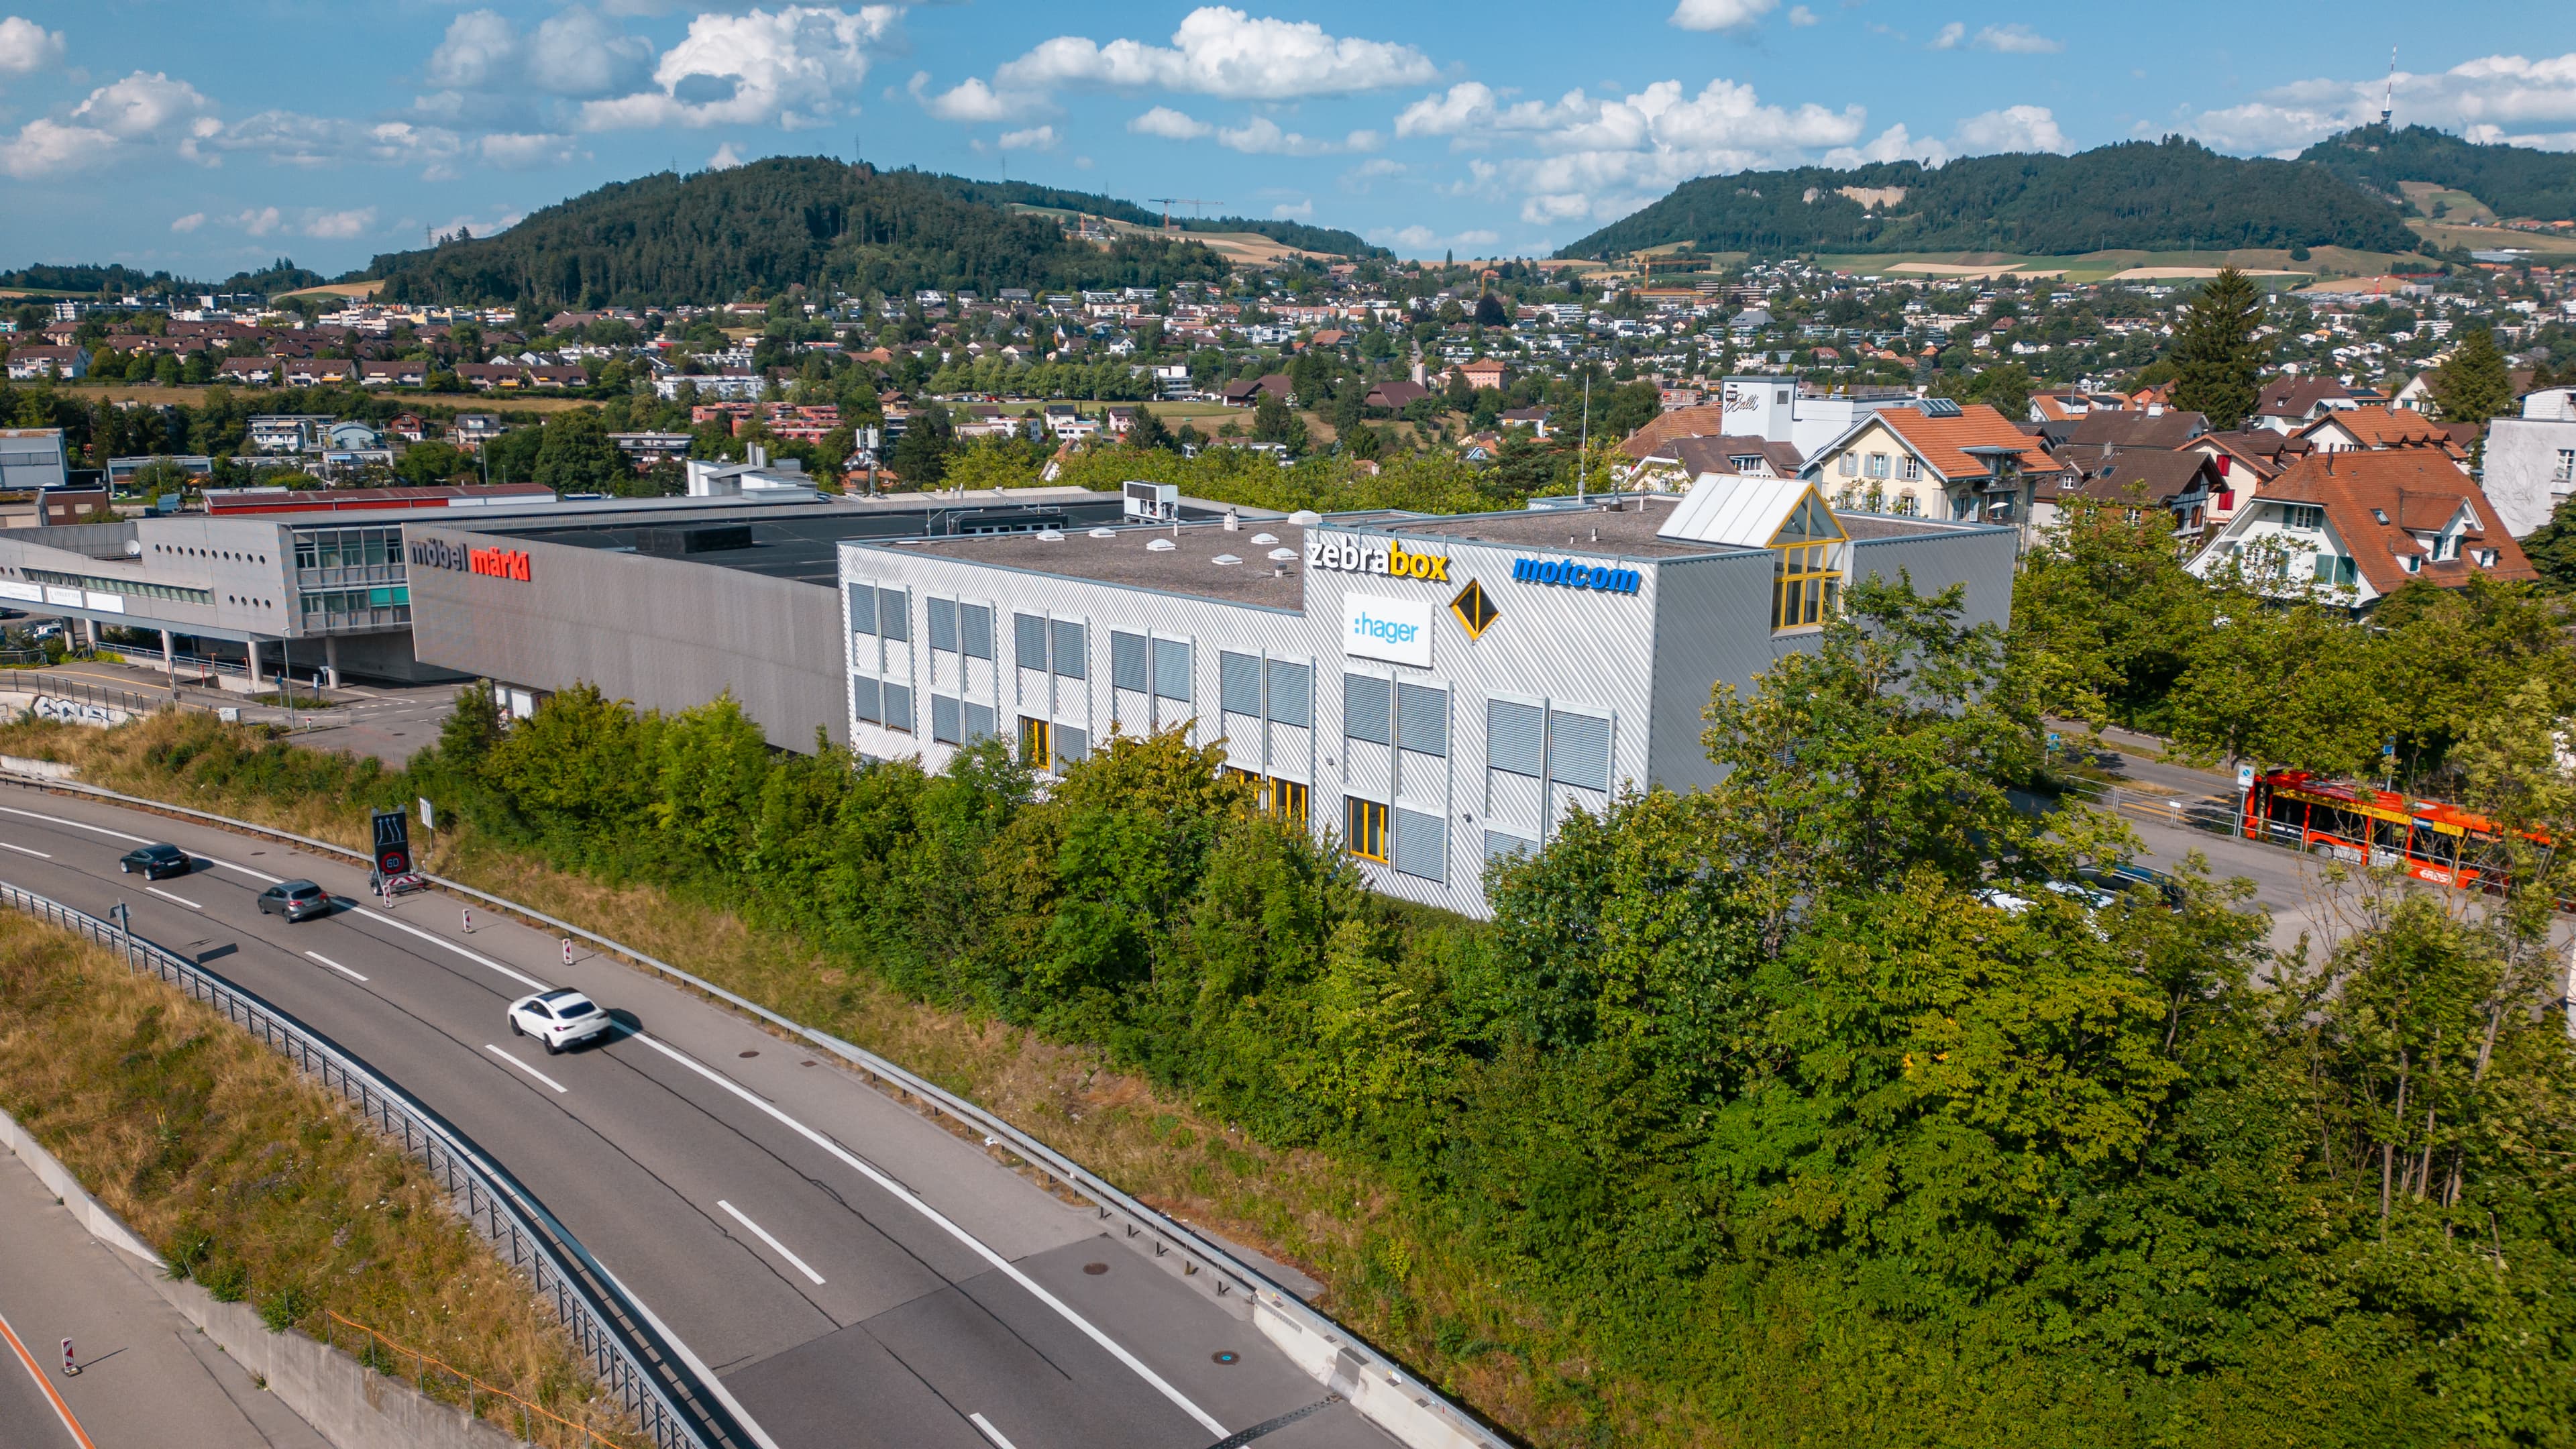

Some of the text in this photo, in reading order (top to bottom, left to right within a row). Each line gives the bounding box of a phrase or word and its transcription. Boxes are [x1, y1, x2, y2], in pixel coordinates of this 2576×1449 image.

[409, 538, 531, 582] möbel märki
[1308, 536, 1448, 582] zebrabox
[1512, 556, 1641, 594] motcom
[386, 858, 399, 868] 60
